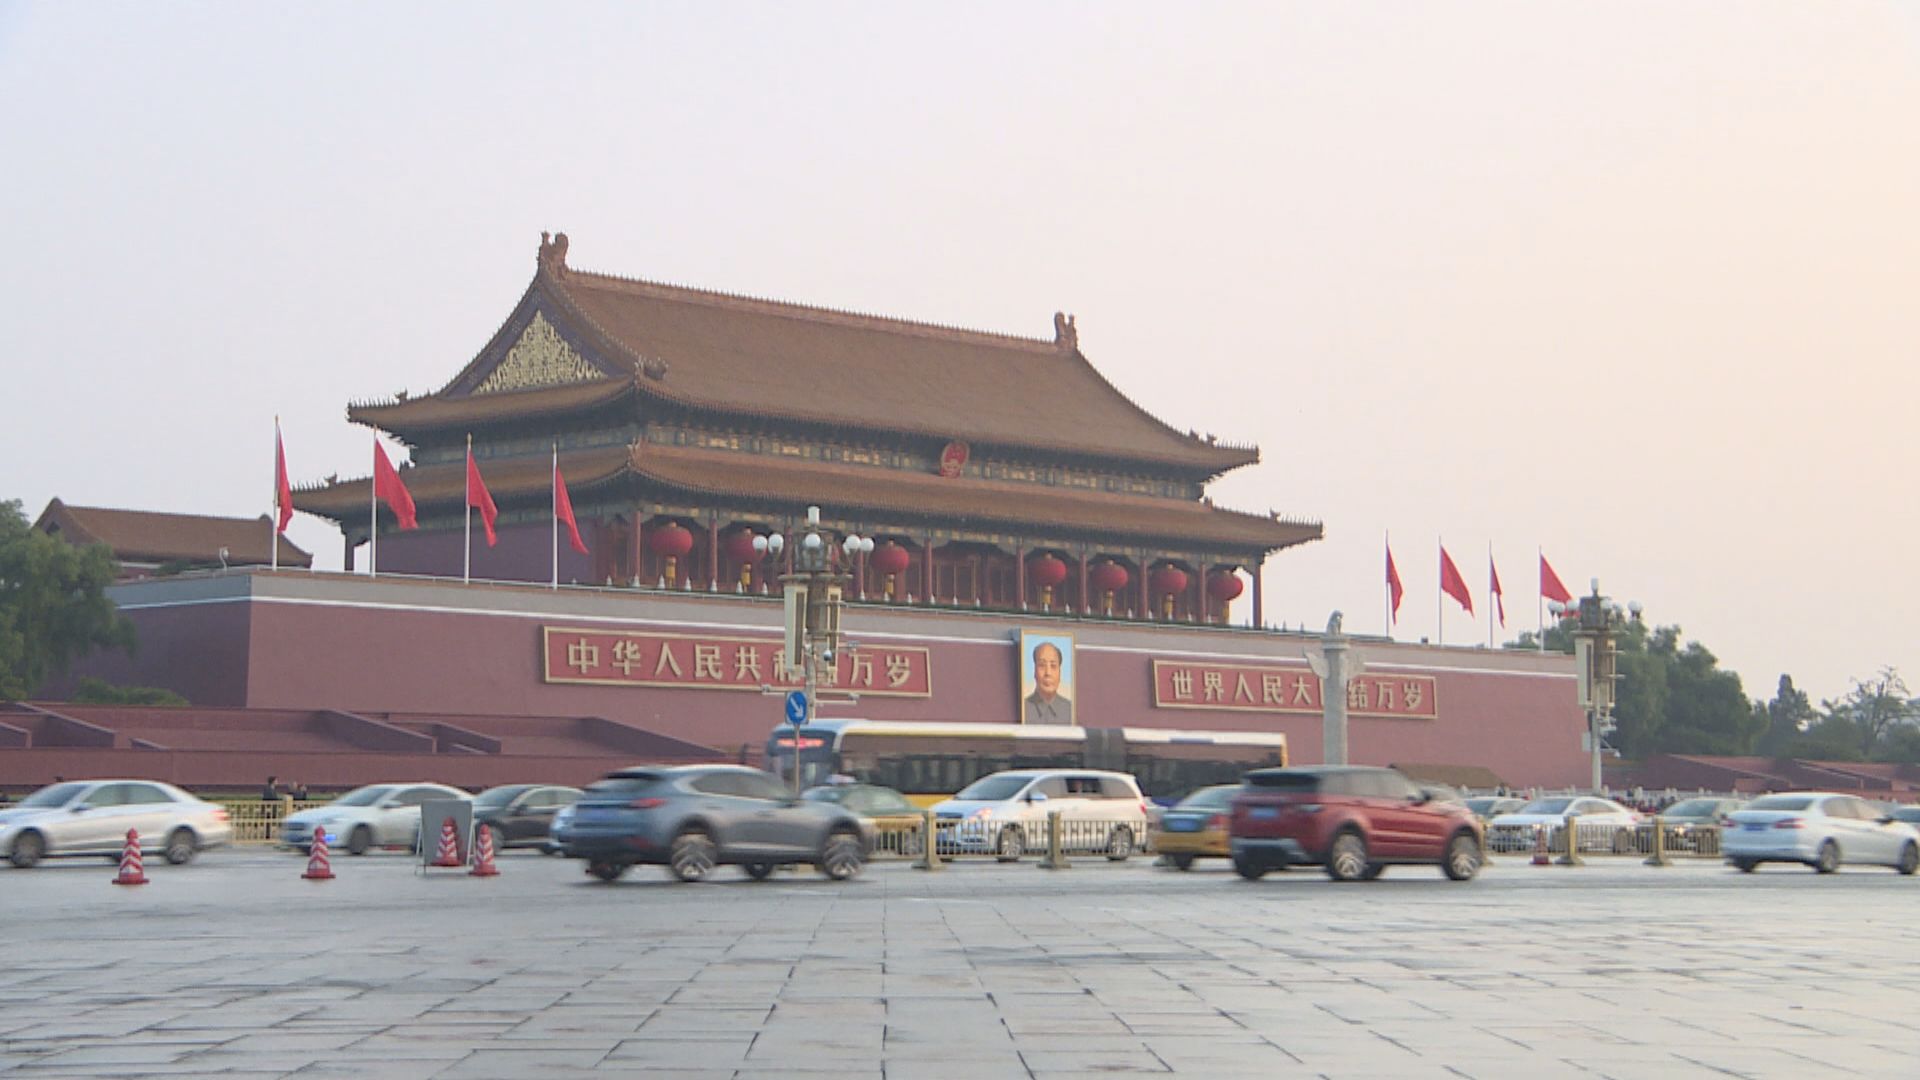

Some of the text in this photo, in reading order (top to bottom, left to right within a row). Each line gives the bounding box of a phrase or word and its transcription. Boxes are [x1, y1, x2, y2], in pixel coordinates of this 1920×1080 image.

[1172, 669, 1422, 710] 世界人民大结万岁
